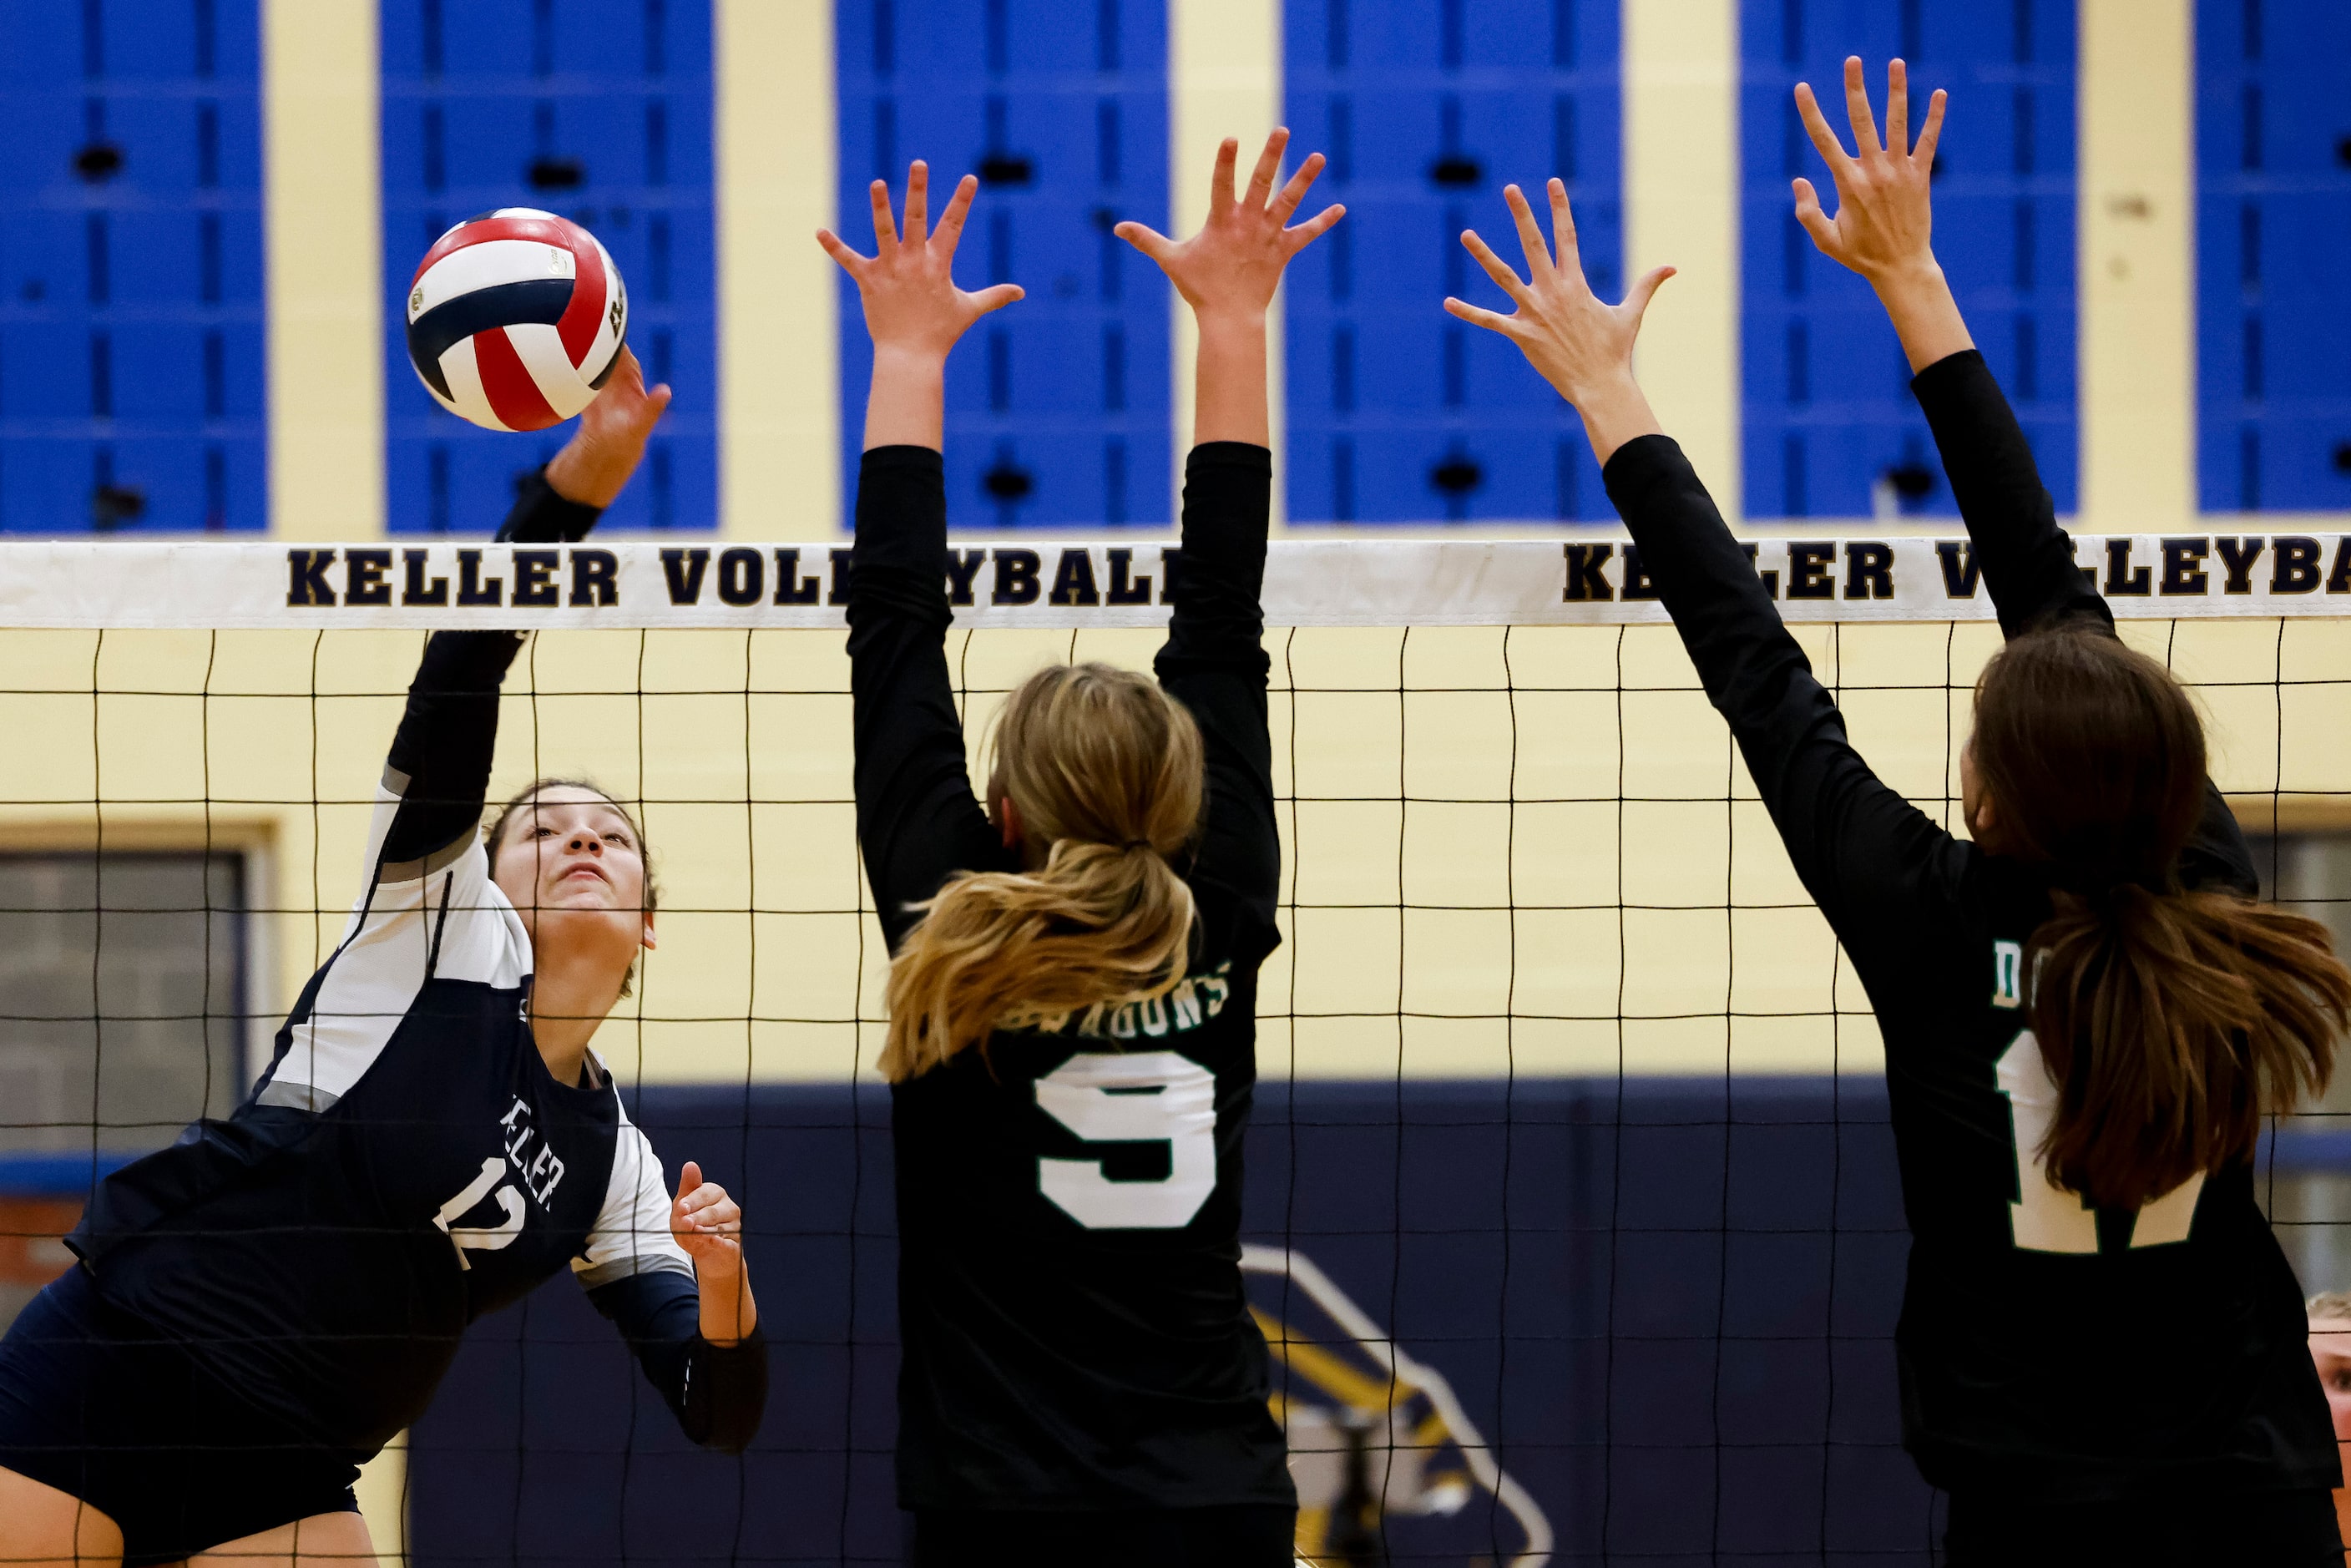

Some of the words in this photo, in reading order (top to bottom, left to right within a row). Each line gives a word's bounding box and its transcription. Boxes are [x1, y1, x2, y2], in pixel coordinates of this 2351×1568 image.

[286, 548, 619, 607] KELLER
[660, 547, 1182, 606] VOLLYBALL
[1563, 541, 1894, 602] KEER
[1934, 536, 2351, 599] VLEYBA
[1006, 961, 1232, 1038] AGONS
[499, 1094, 565, 1212] ELER
[1032, 1050, 1216, 1230] 9
[432, 1156, 527, 1272] 12
